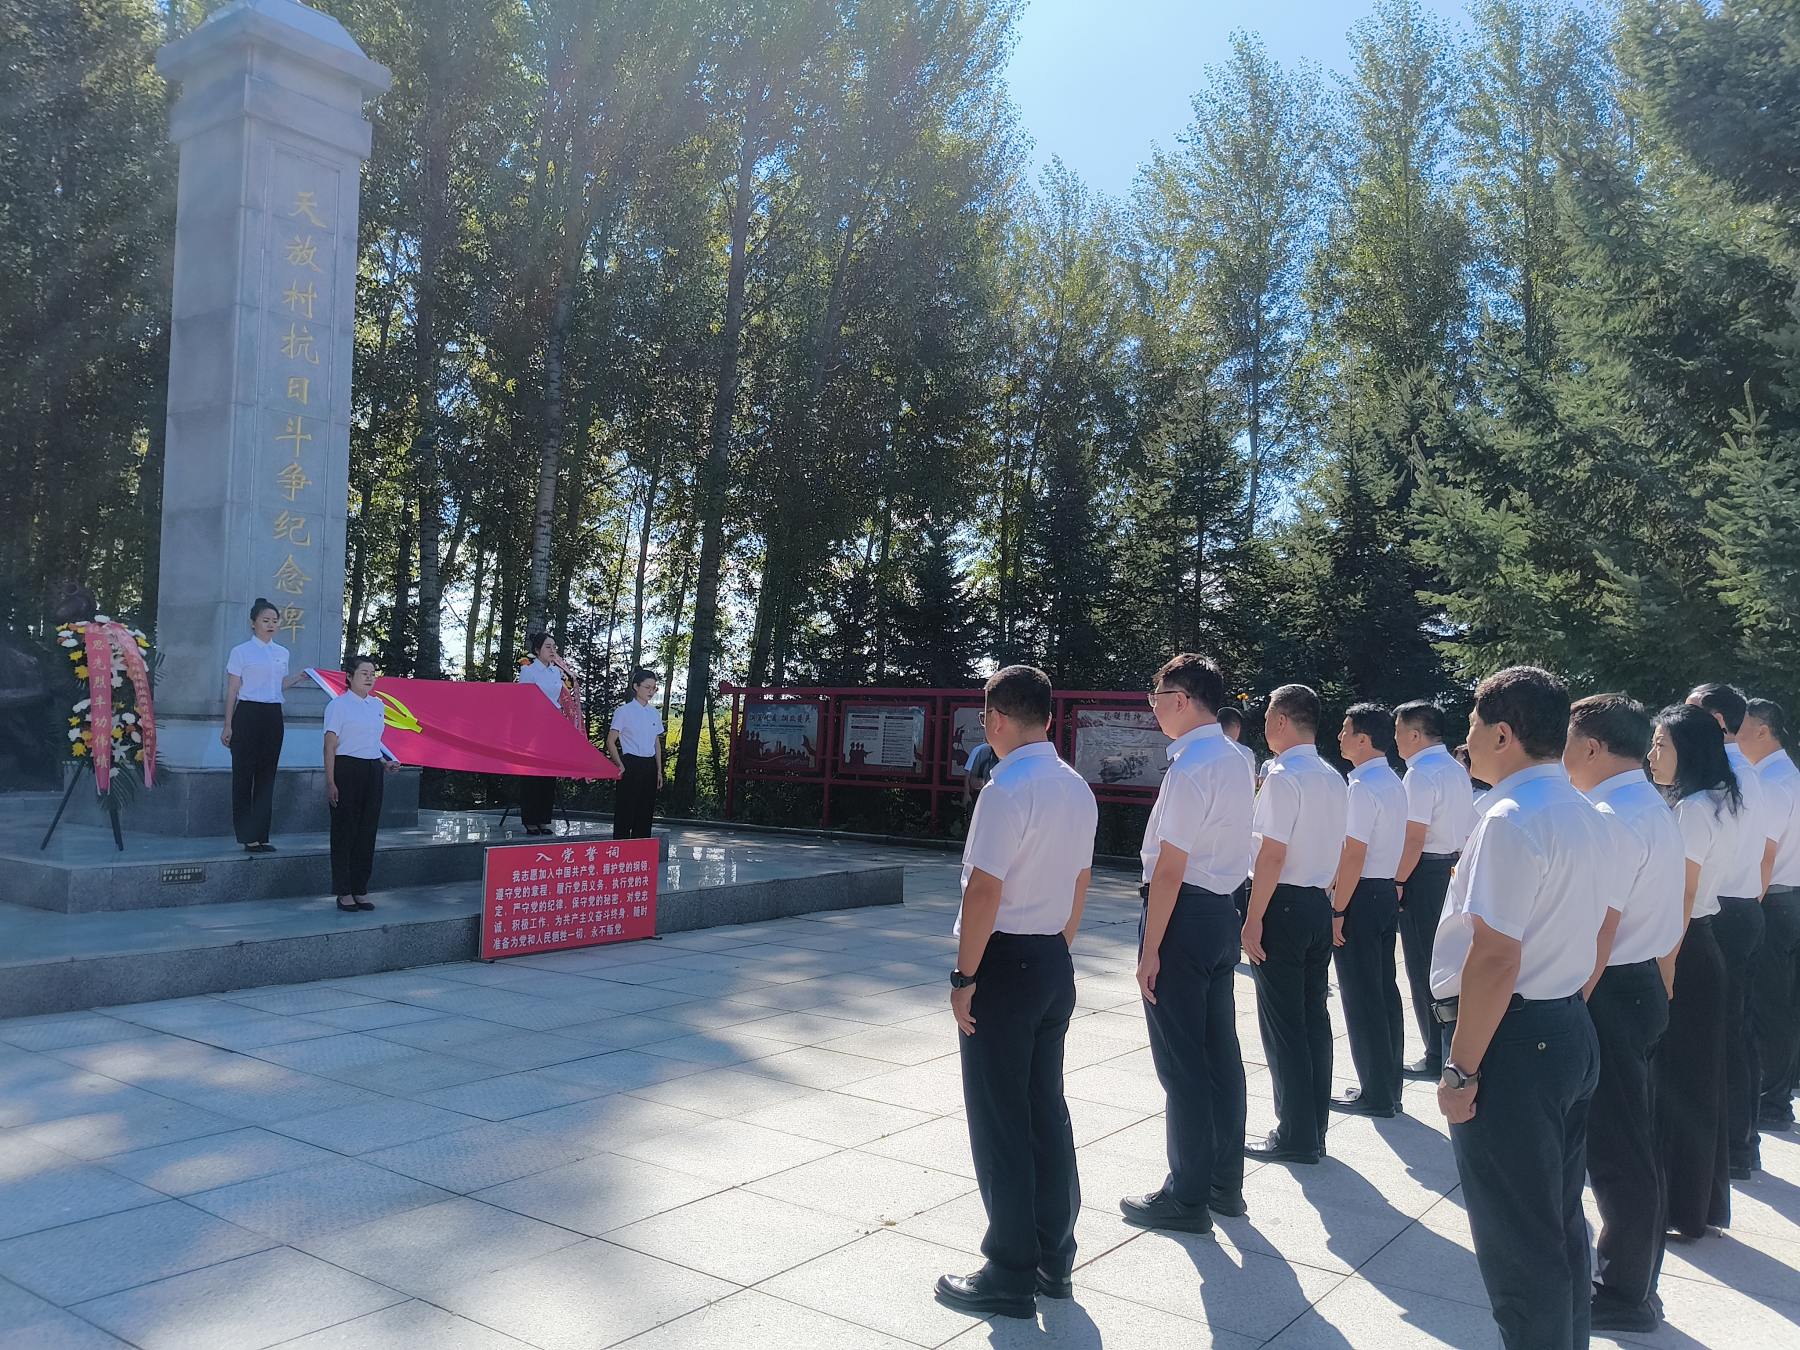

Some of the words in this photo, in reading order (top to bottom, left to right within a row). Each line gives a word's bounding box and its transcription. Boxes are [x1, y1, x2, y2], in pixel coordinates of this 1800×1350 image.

[272, 190, 328, 642] 天放村抗日斗争纪念碑
[535, 845, 620, 863] 入党誓词
